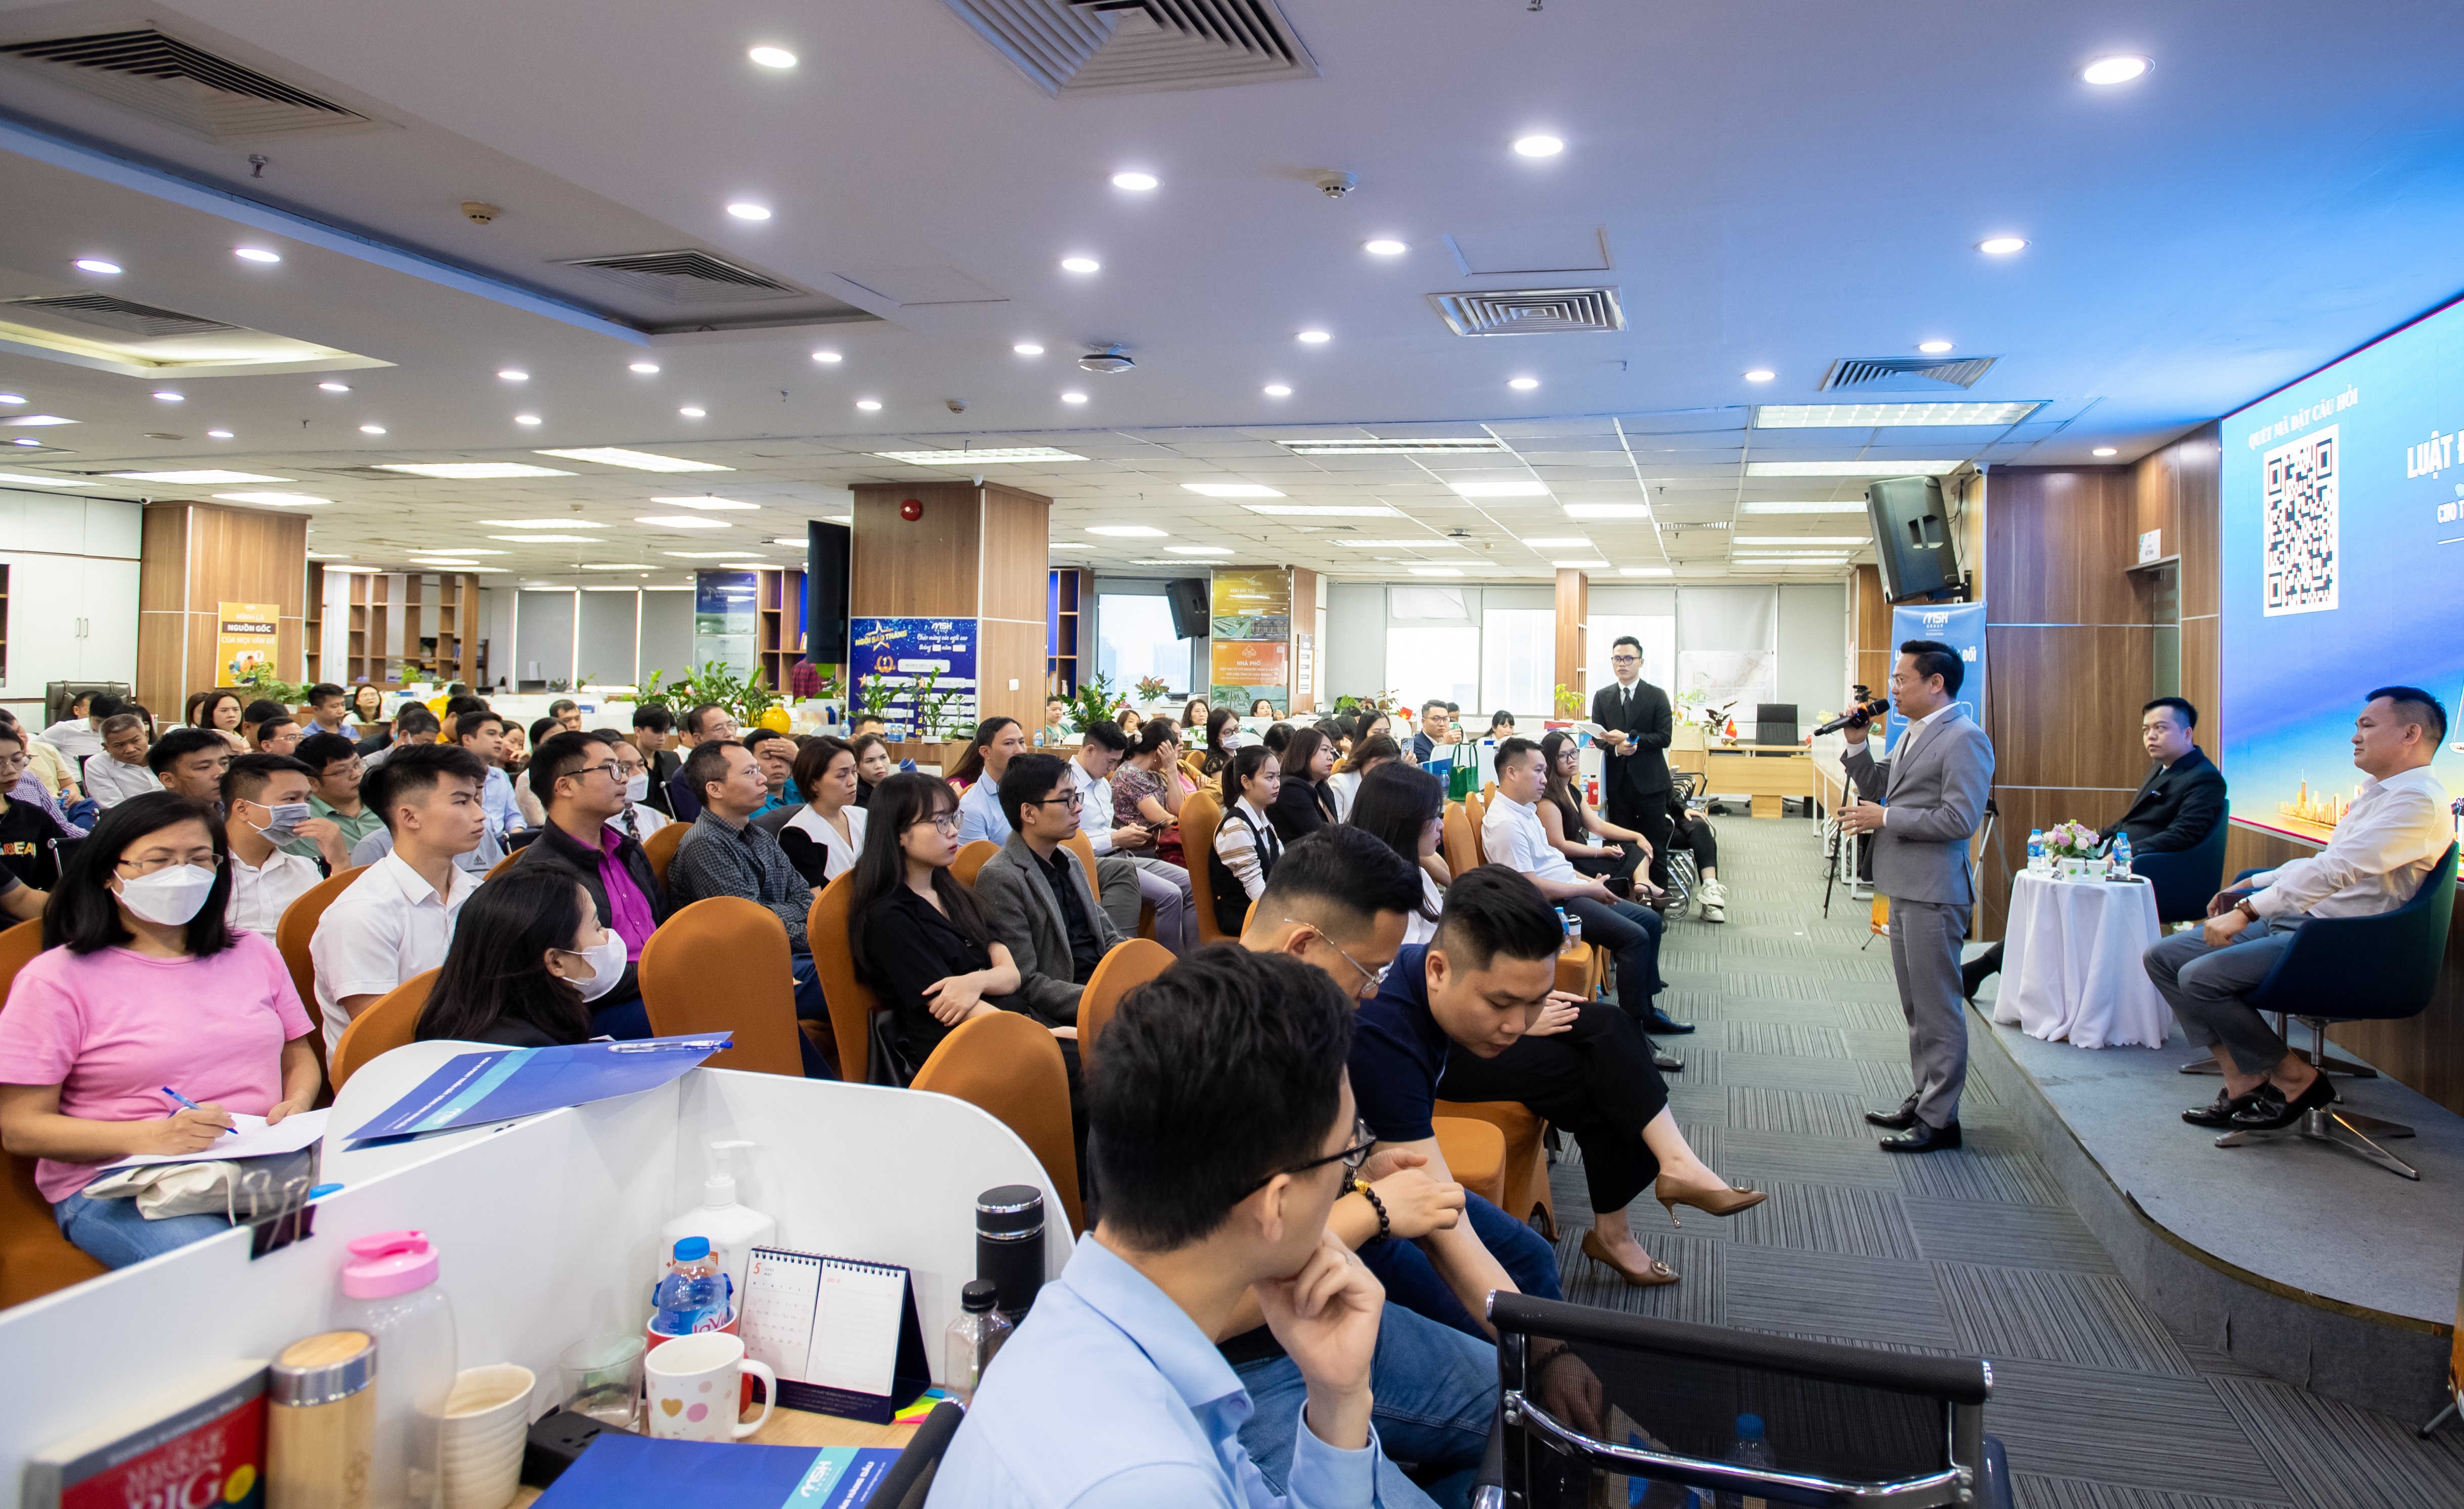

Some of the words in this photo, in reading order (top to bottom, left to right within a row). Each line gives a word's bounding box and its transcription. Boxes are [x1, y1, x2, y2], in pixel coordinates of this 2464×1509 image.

[2248, 425, 2273, 450] QUÉT
[2312, 398, 2334, 422] CÂU
[2336, 384, 2358, 412] HỎI
[2407, 429, 2453, 480] LUẬT
[2437, 501, 2456, 524] CHO
[1922, 612, 1949, 624] MSH
[228, 623, 255, 631] NGUỒN
[255, 624, 272, 632] GỐC
[237, 637, 250, 645] MỌI
[251, 636, 265, 645] VẤN
[855, 636, 871, 646] NGÔI
[871, 634, 885, 644] SAO
[885, 630, 908, 640] THÁNG
[882, 657, 887, 665] 1
[753, 1262, 761, 1274] 5
[800, 1460, 832, 1498] MSH
